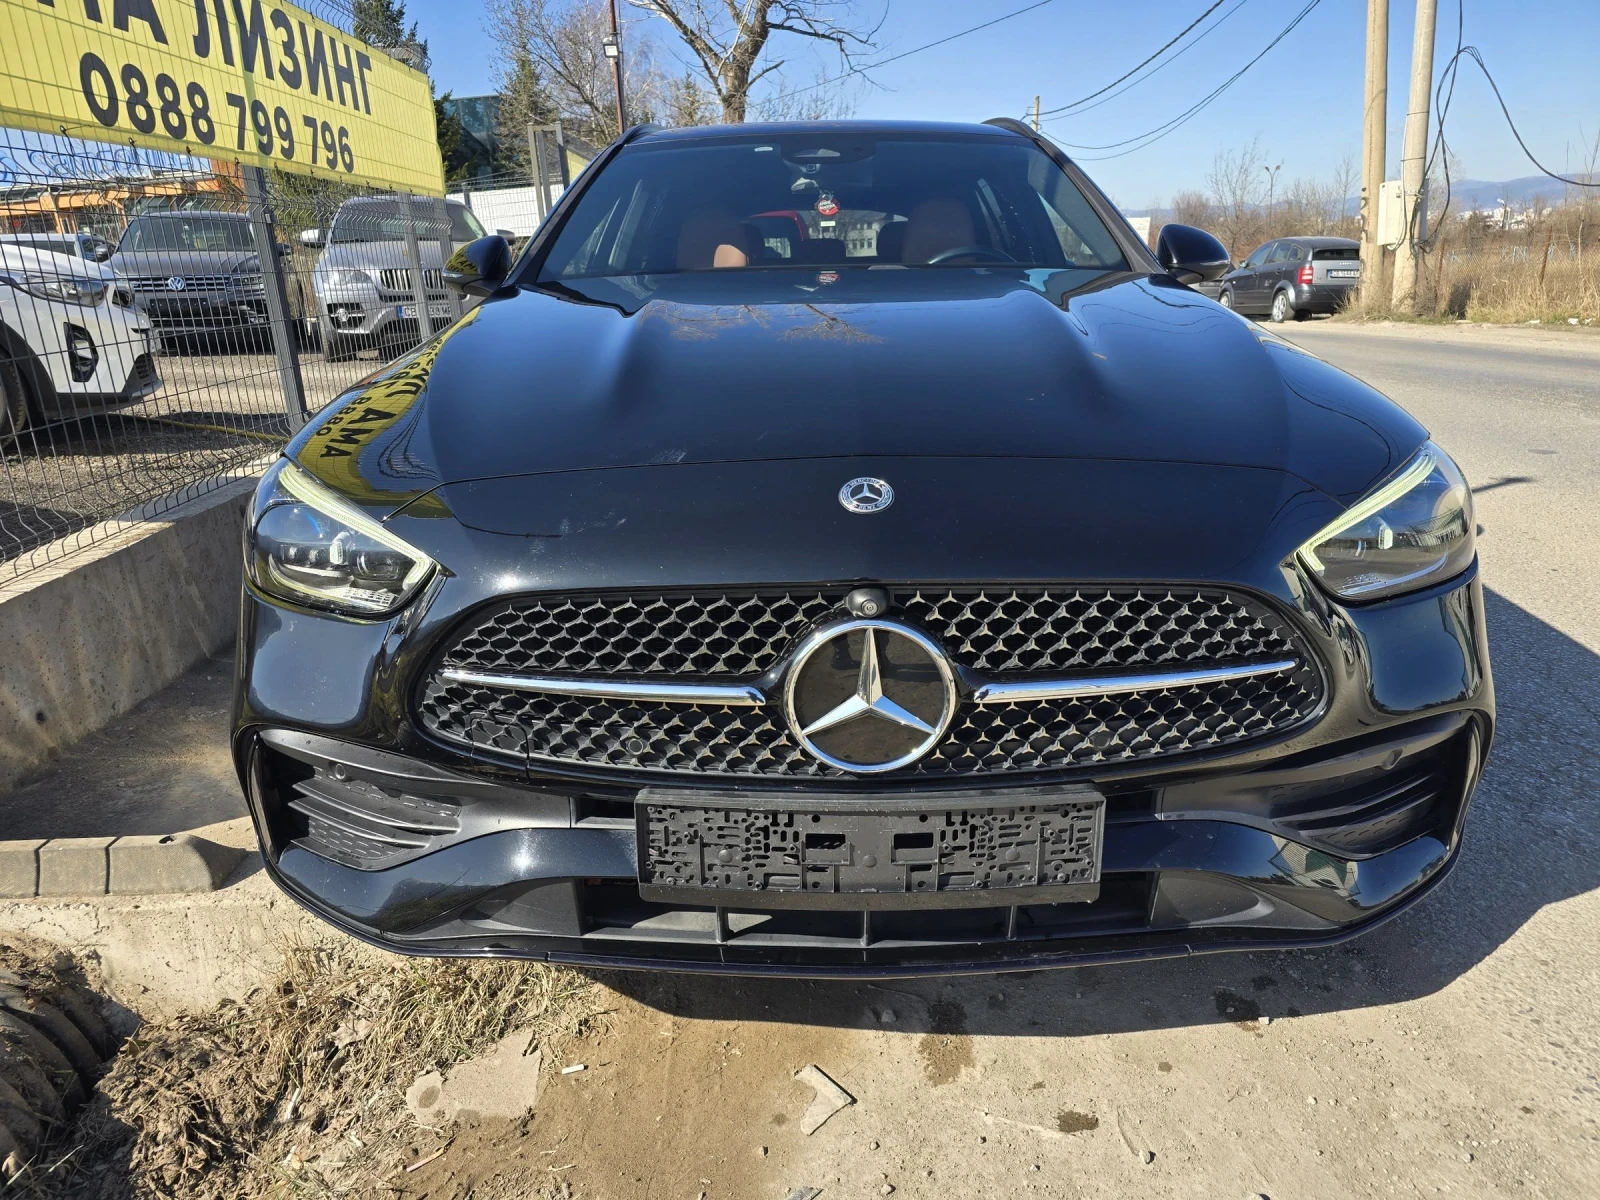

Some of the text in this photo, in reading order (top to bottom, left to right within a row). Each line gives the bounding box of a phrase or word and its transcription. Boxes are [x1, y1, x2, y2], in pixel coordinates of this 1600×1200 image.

[79, 51, 354, 174] 0888 799 796
[193, 0, 373, 116] ЛИЗИНГ
